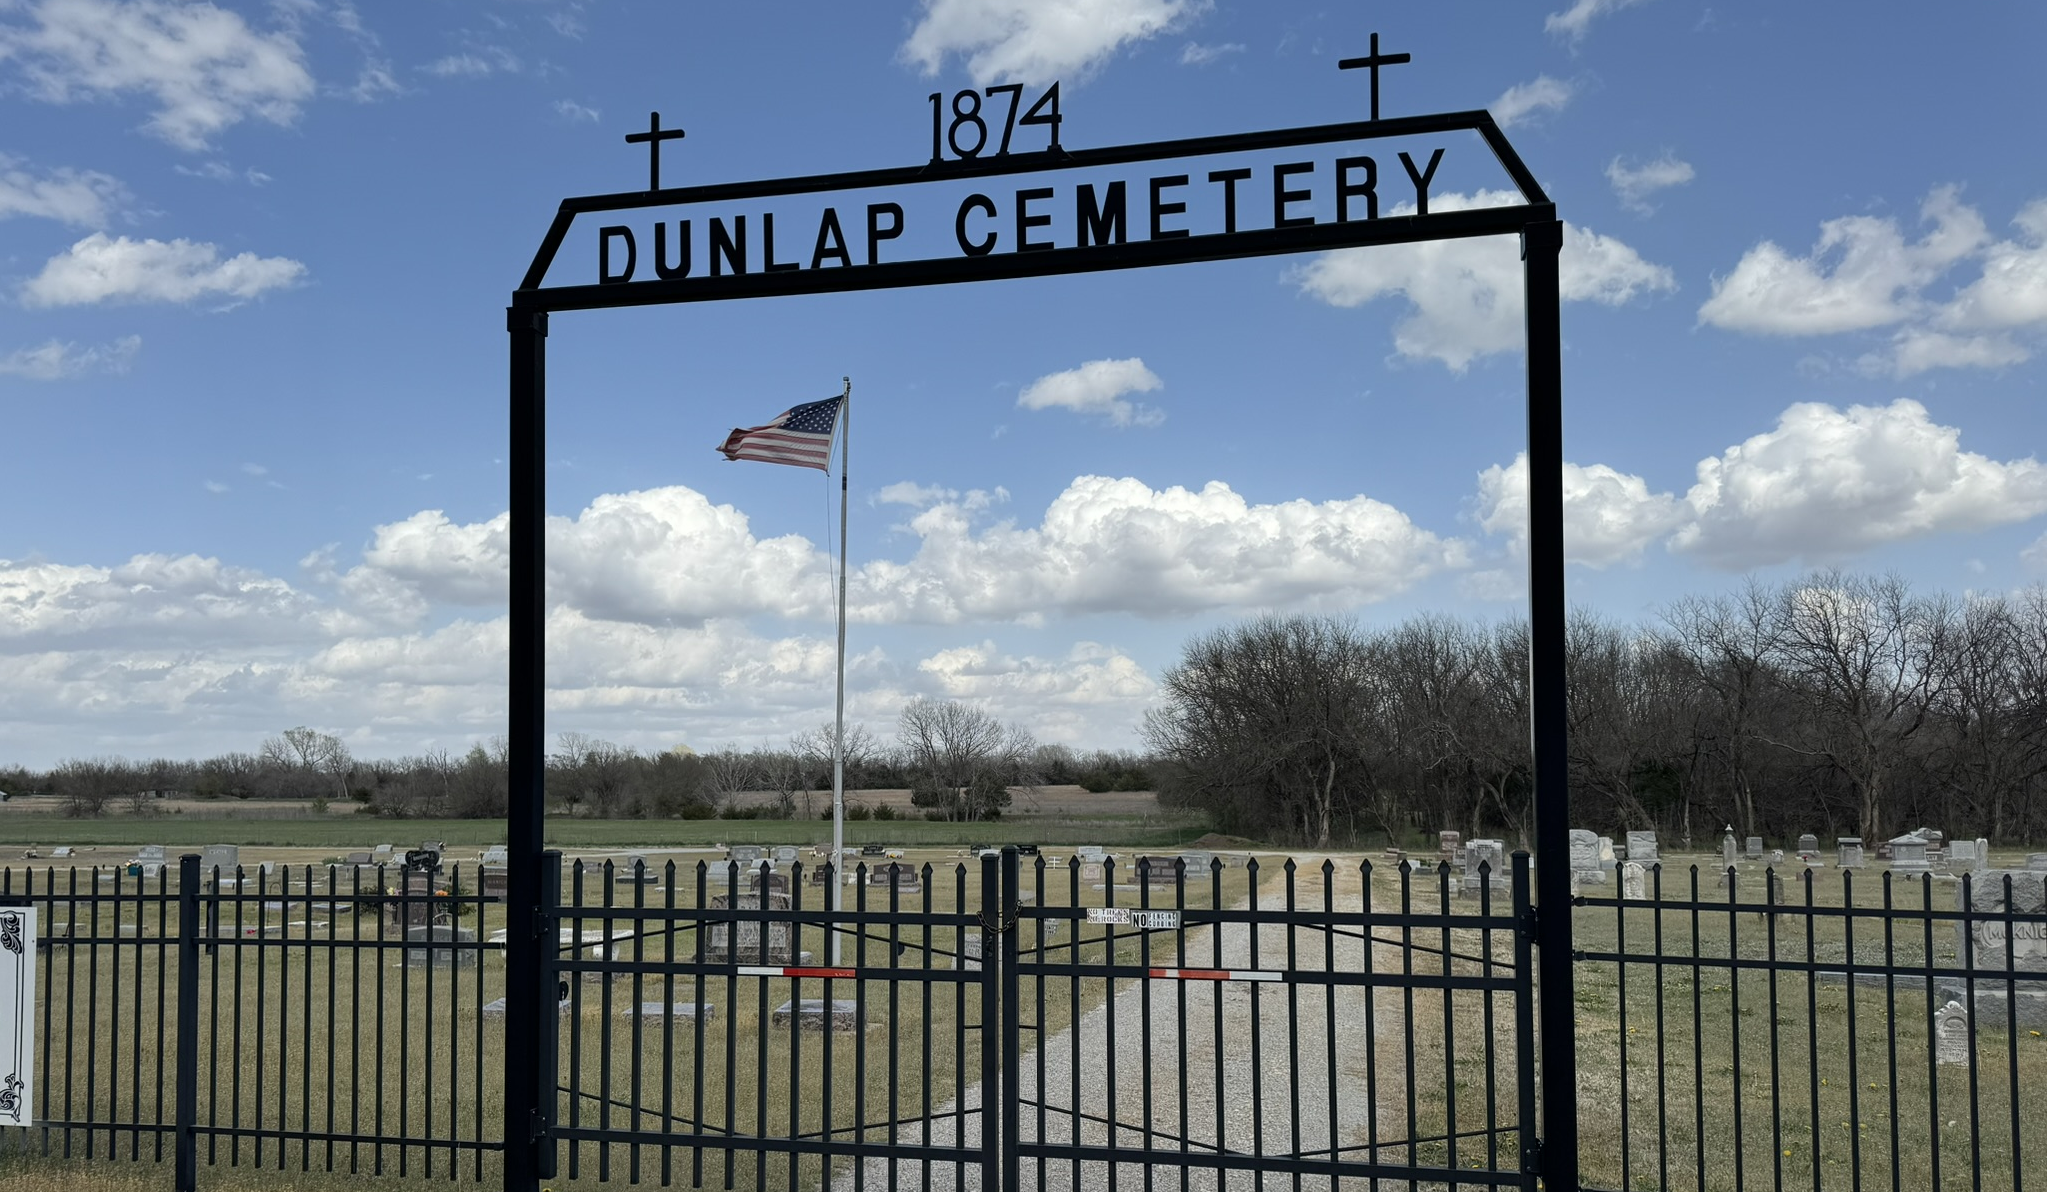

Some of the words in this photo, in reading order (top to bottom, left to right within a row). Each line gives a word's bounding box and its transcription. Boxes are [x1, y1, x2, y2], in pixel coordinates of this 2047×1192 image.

[929, 80, 1063, 161] 1874
[599, 202, 904, 285] DUNLAP
[955, 148, 1446, 257] CEMETERY
[1133, 913, 1147, 927] NO
